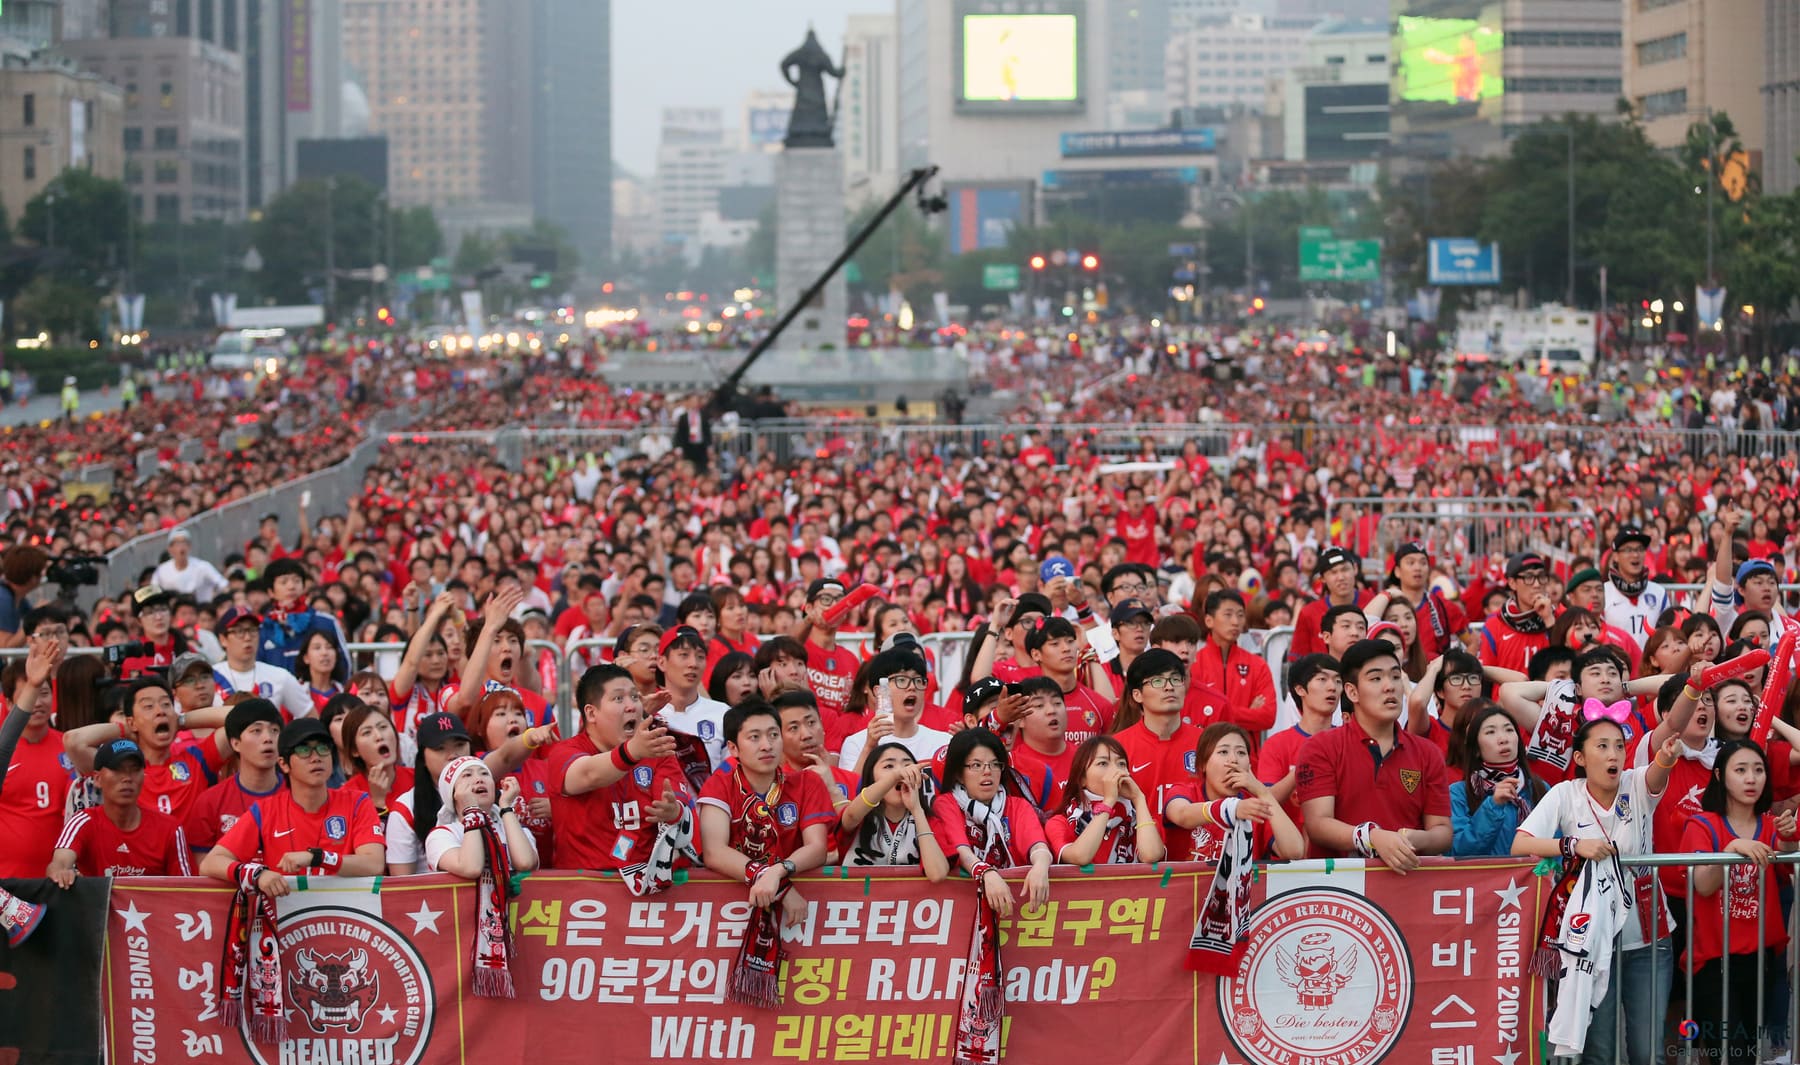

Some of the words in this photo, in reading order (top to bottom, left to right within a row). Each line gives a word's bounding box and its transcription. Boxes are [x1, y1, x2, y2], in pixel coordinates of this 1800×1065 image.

[1630, 615, 1644, 634] 17
[807, 667, 846, 688] KOREA
[36, 781, 49, 808] 9
[157, 794, 171, 815] 9
[611, 800, 640, 830] 19
[1157, 784, 1173, 815] 1
[509, 899, 607, 947] 석은
[625, 901, 750, 948] 뜨거운
[1497, 912, 1521, 979] SINCE
[126, 935, 155, 1000] SINCE
[1295, 904, 1374, 936] REALRED
[1373, 936, 1398, 1001] BAND
[174, 910, 223, 1057] 리얼레
[281, 922, 336, 950] FOOTBALL
[338, 922, 372, 944] TEAM
[370, 935, 420, 1005] SUPPORTERS
[403, 1006, 421, 1038] CLUB
[539, 957, 730, 1005] 90분간의
[866, 956, 1117, 1005] R.U.Rady?
[131, 1007, 157, 1065] 2002
[650, 1016, 755, 1059] With
[772, 1014, 1012, 1062] 리!얼!레!!
[1274, 1013, 1311, 1029] Die
[1313, 1012, 1360, 1029] besten
[1497, 986, 1520, 1044] 2002
[279, 1031, 400, 1065] REALRED
[1255, 1036, 1294, 1065] DIE
[1299, 1036, 1378, 1065] BESTEN
